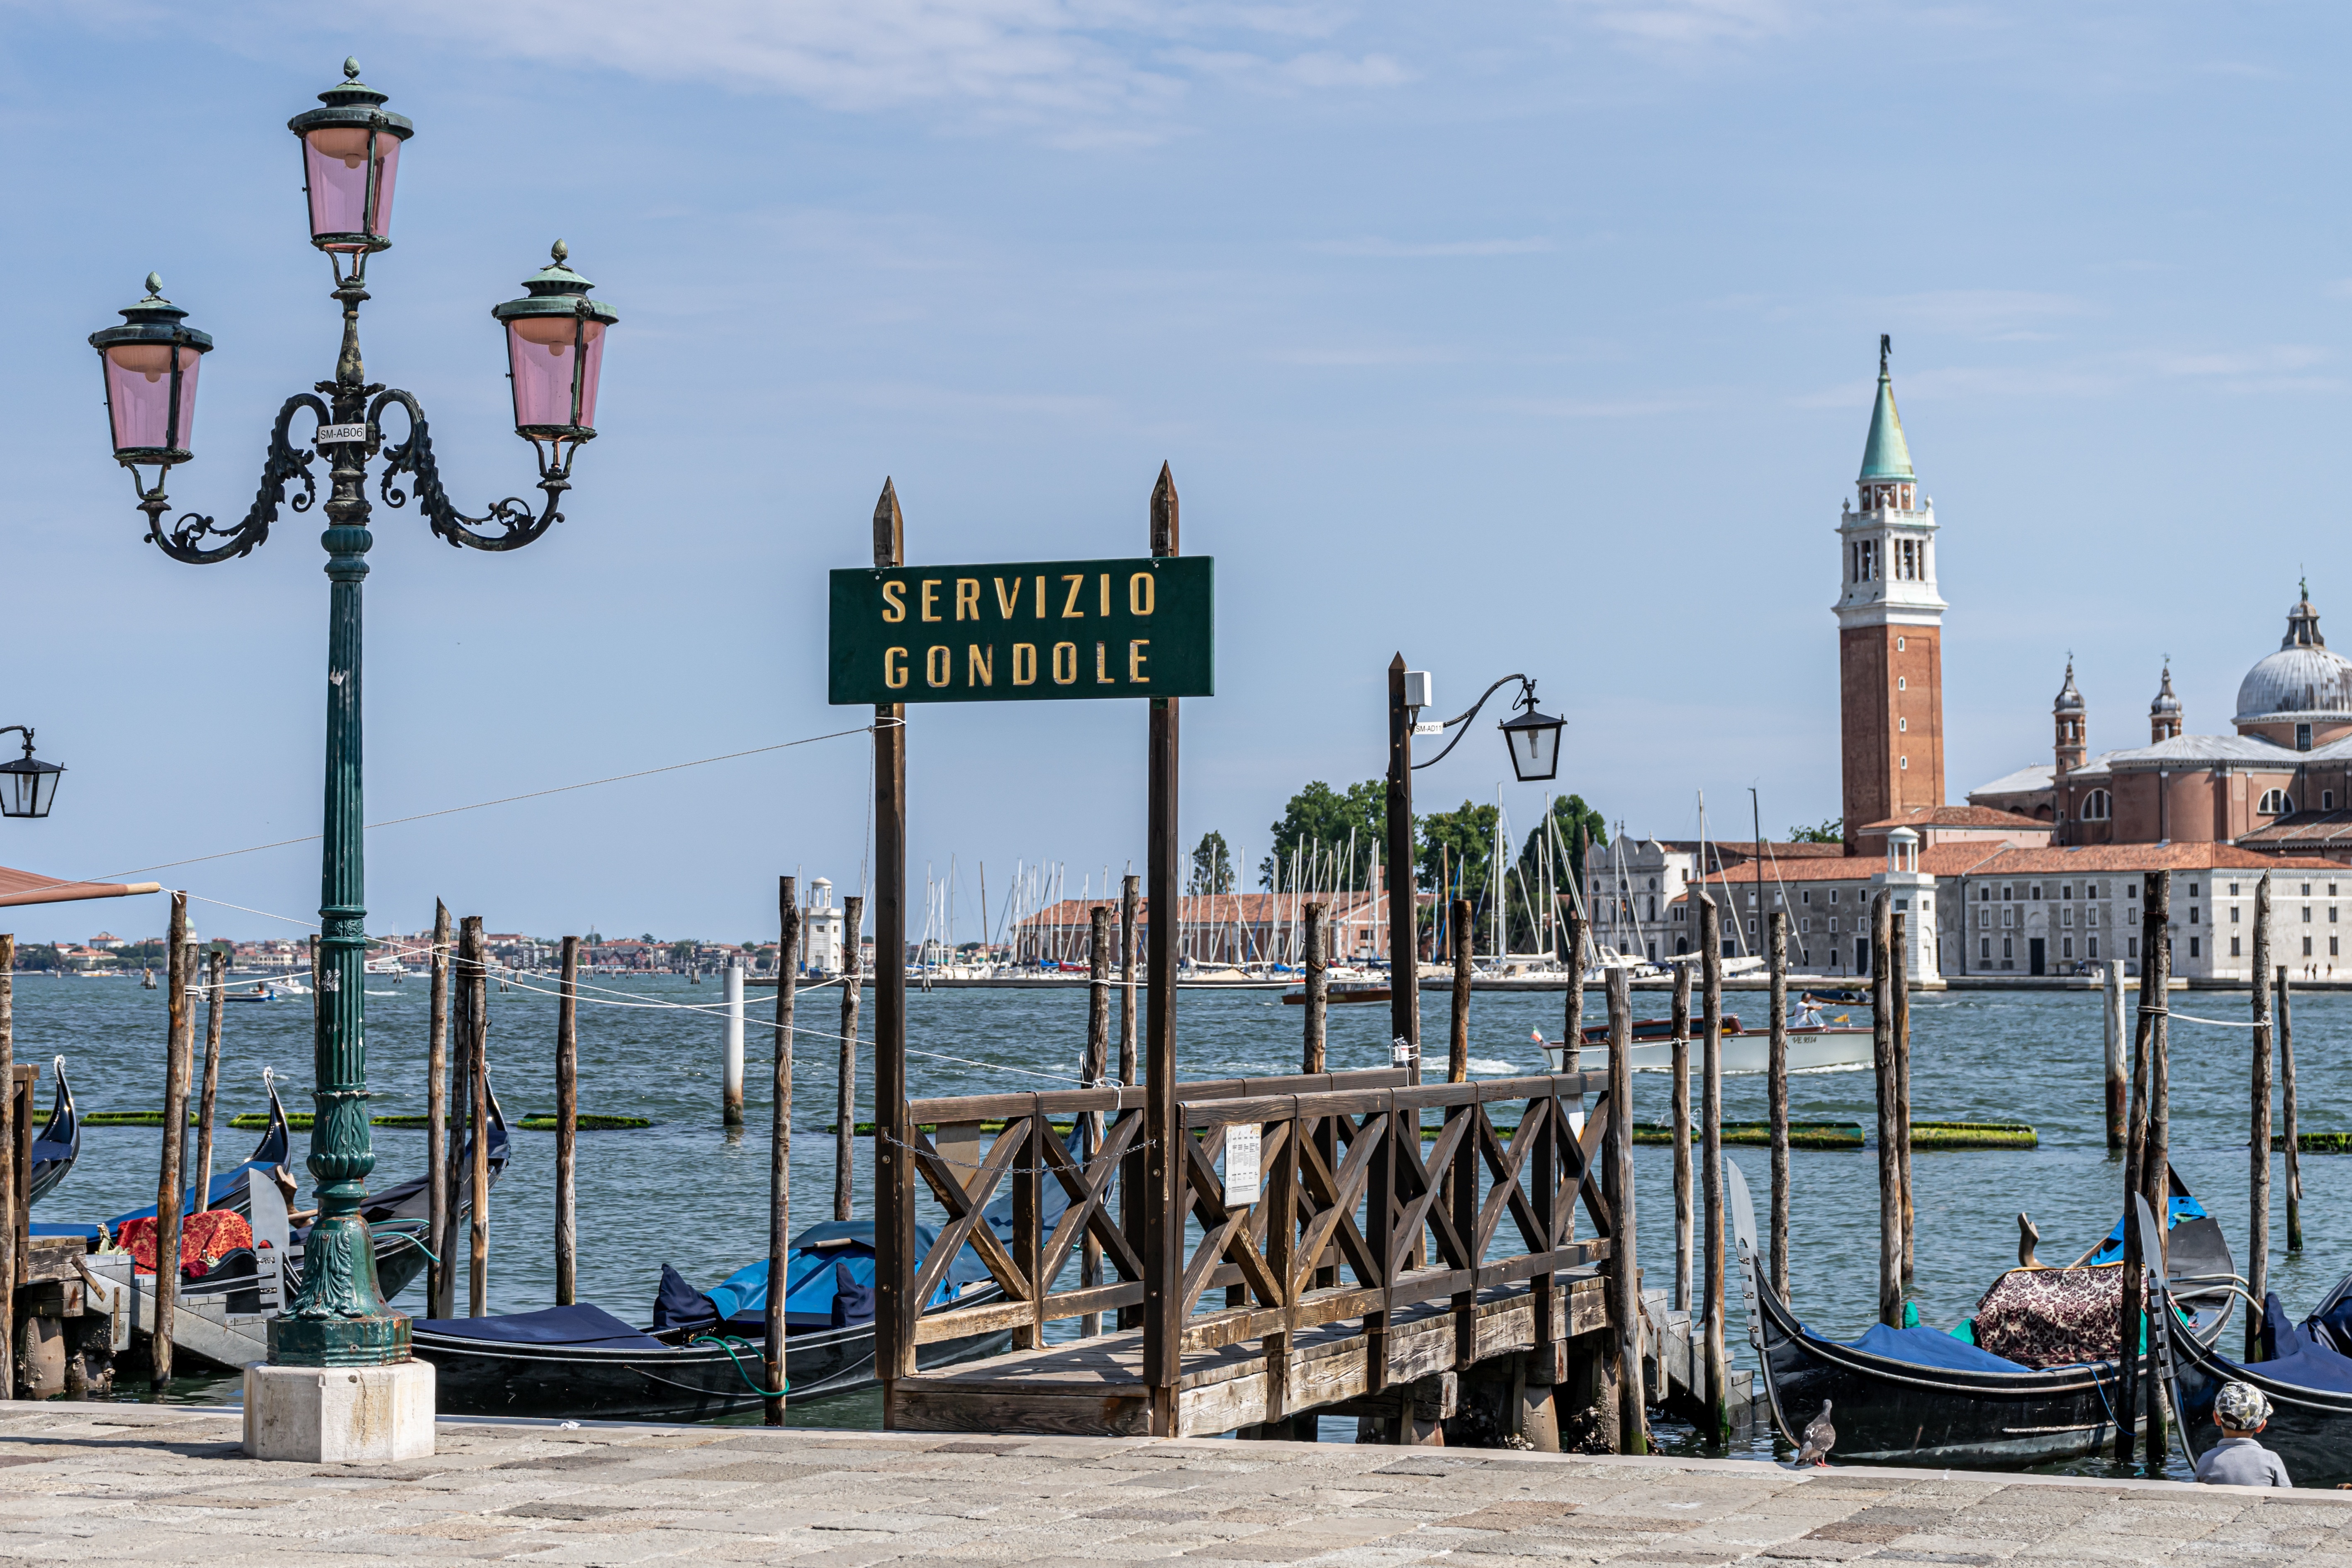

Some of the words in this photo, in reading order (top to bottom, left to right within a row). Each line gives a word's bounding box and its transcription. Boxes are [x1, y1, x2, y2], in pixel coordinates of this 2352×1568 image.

[321, 427, 363, 439] SM-AB06
[882, 572, 1154, 623] SERVIZIO
[885, 639, 1150, 689] GONDOLE
